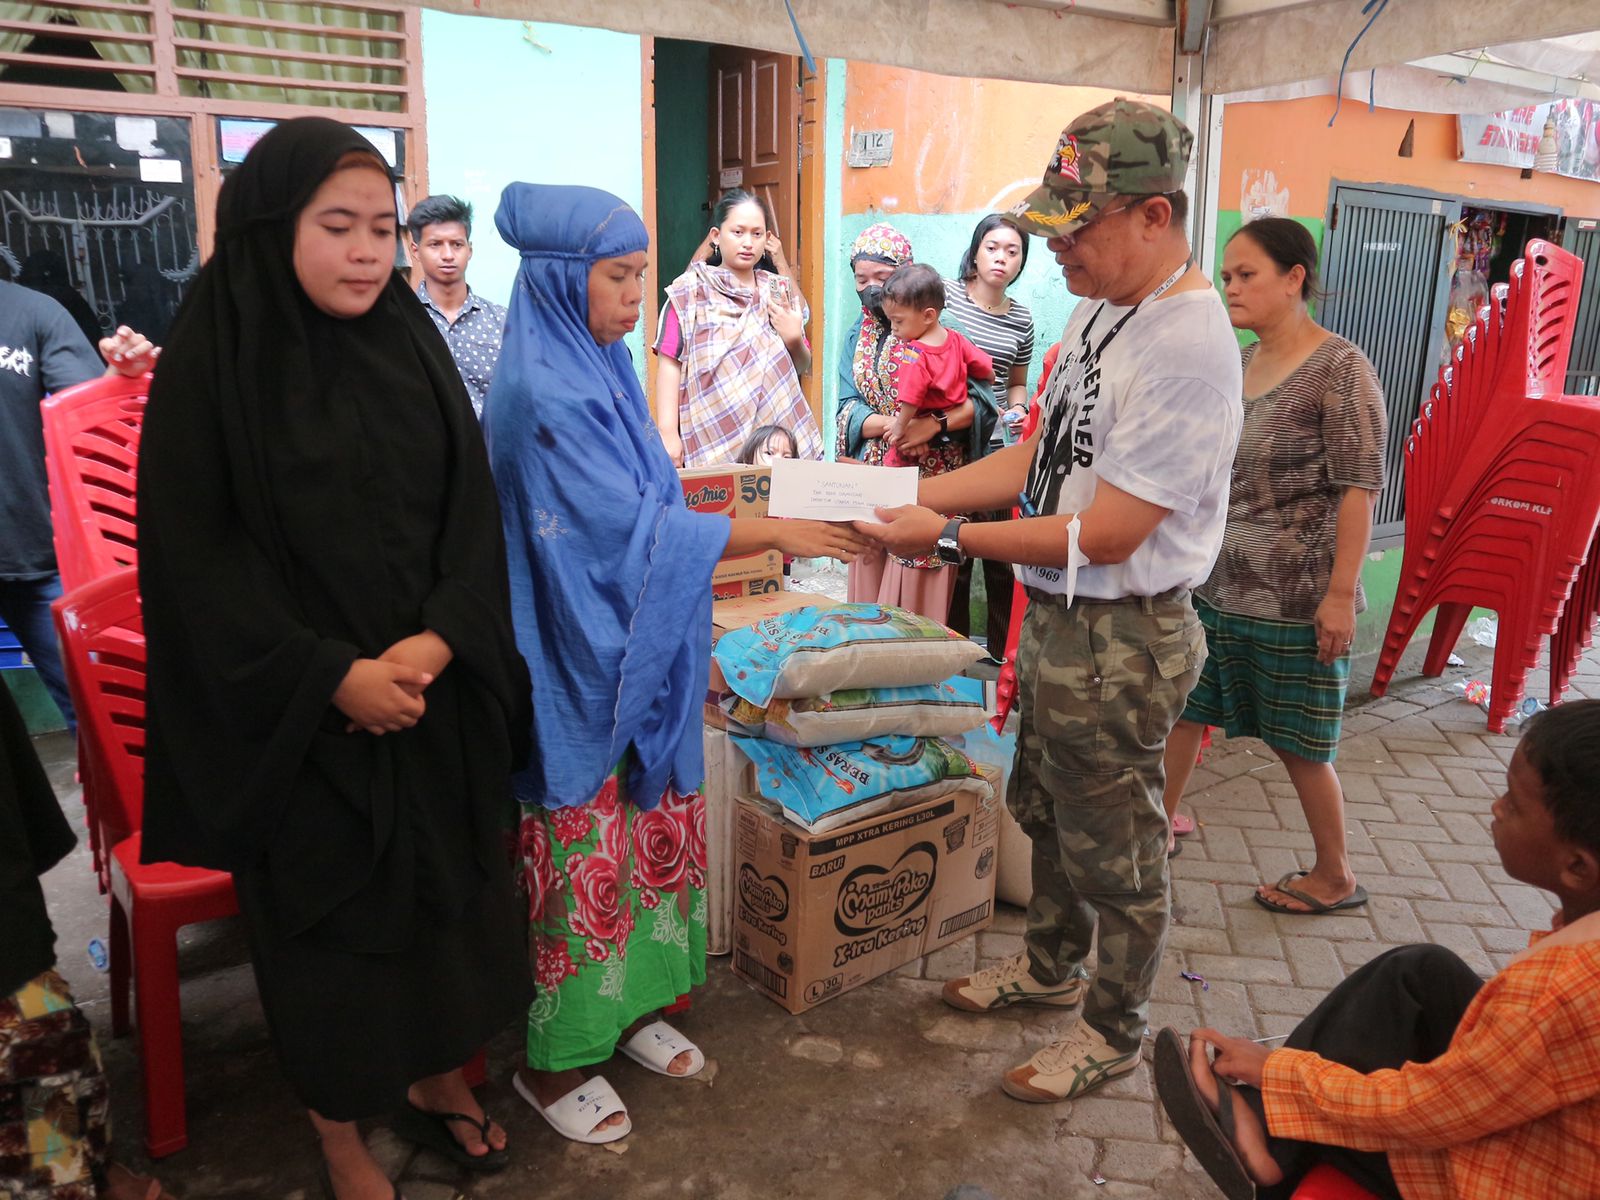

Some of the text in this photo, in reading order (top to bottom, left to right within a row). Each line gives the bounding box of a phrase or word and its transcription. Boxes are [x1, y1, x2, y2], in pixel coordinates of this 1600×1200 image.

[826, 752, 870, 785] BERAS
[835, 836, 855, 848] MPP
[857, 828, 881, 841] XTRA
[882, 818, 914, 833] KERING
[810, 856, 845, 878] BARU!
[843, 869, 929, 919] MamyPoko
[865, 897, 904, 924] pants
